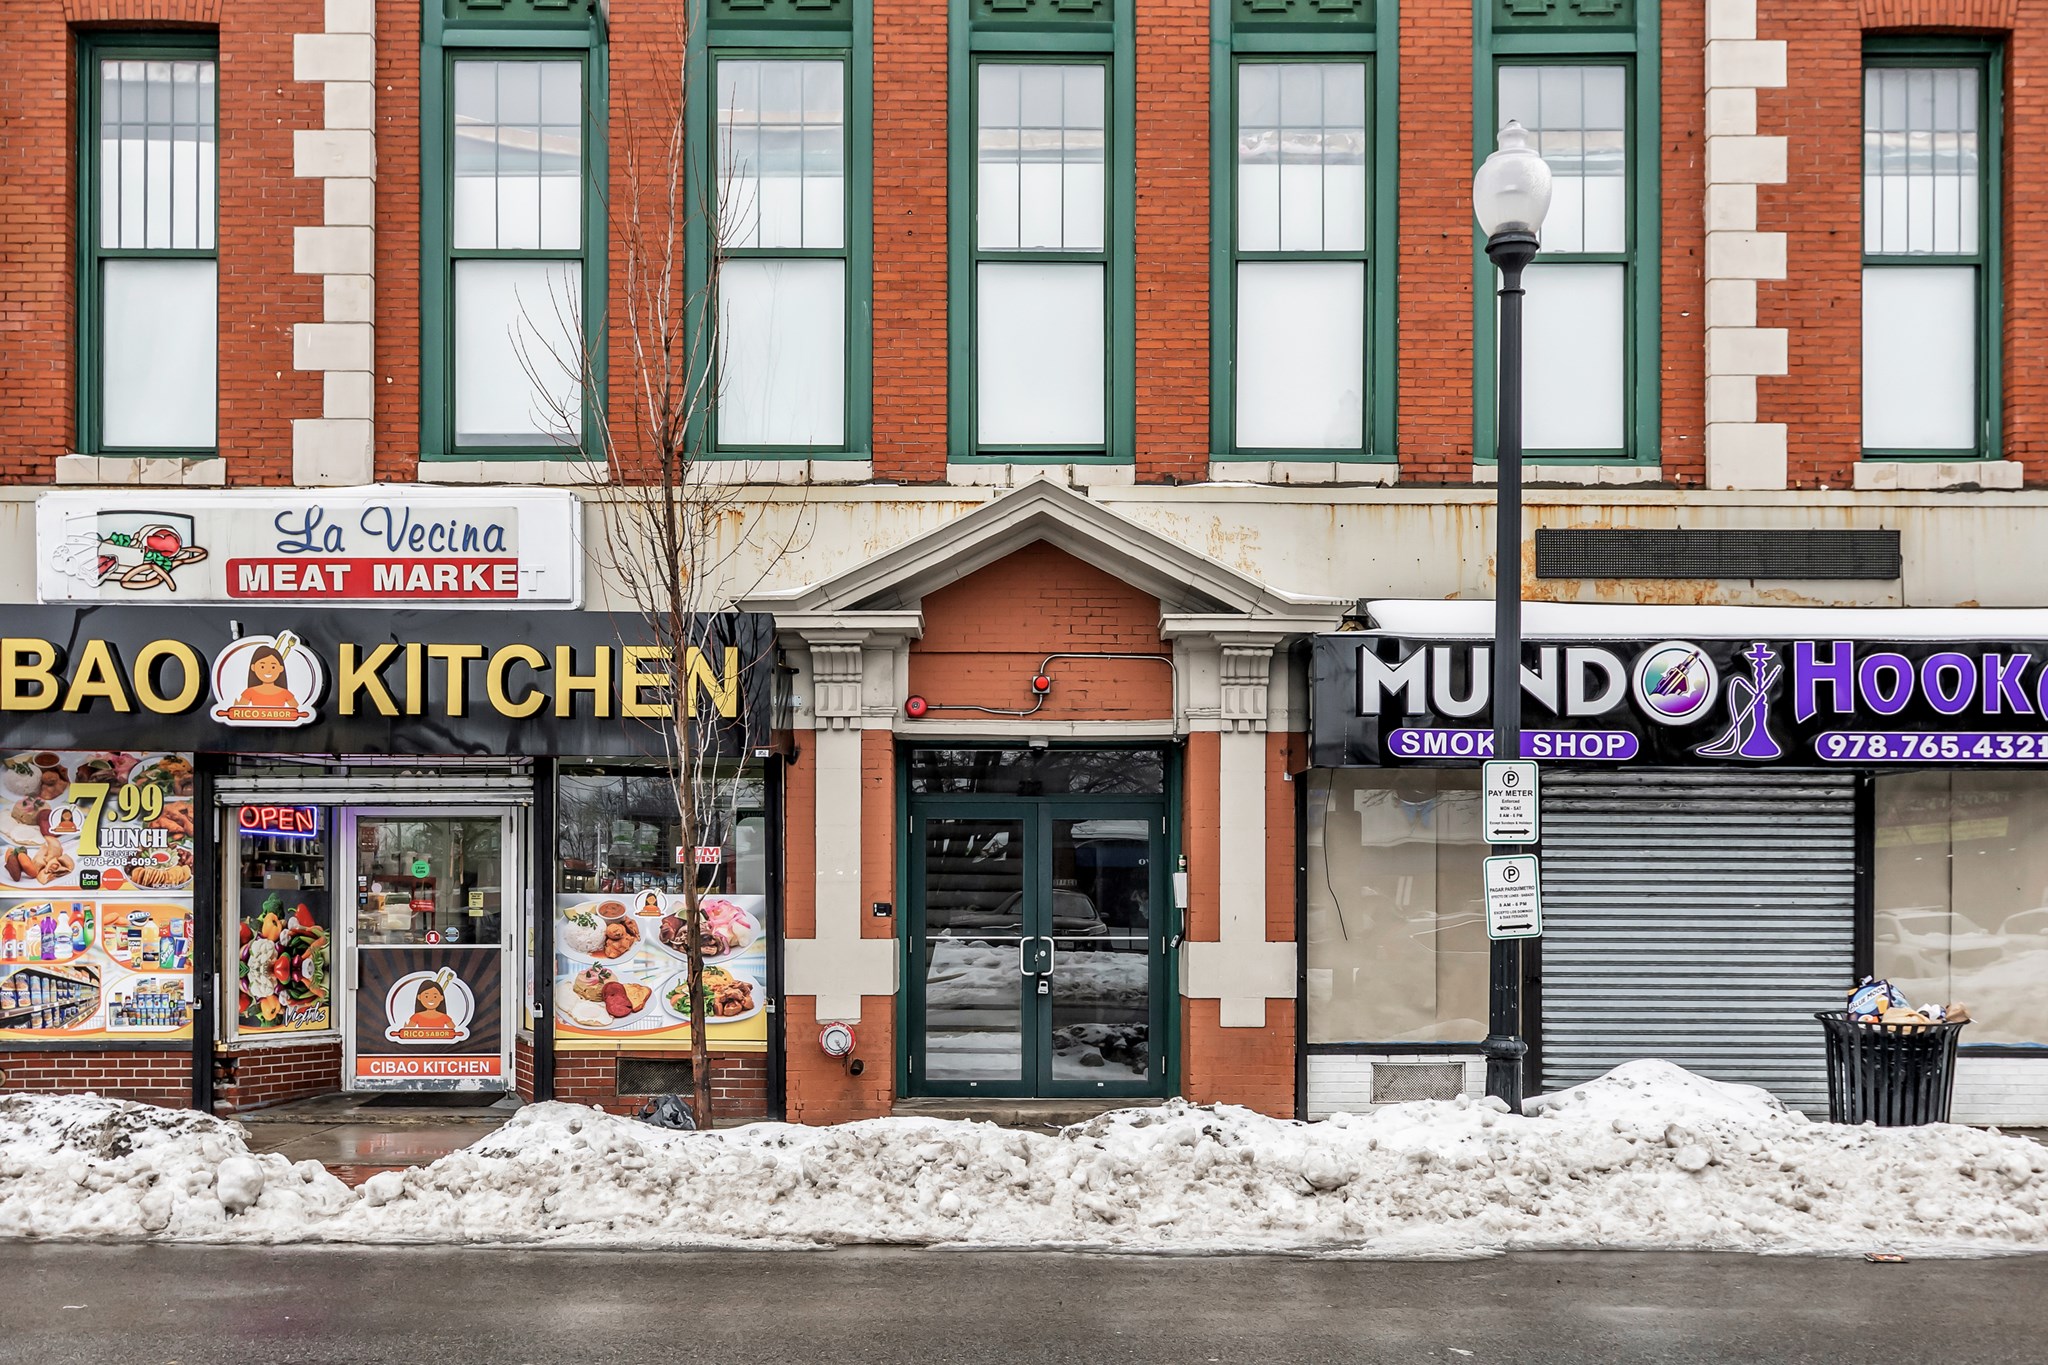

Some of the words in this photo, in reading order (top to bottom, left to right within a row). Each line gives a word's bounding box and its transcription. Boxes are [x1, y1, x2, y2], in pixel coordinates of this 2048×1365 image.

[275, 505, 345, 554] La
[360, 506, 507, 552] Vecina
[238, 564, 351, 592] MEAT
[373, 564, 546, 592] MARKET
[0, 638, 200, 714] BAO
[338, 643, 739, 719] KITCHEN
[1794, 641, 2048, 724] HOOK
[233, 708, 260, 719] RICO
[261, 709, 292, 719] SABOR
[1401, 731, 1494, 756] SMOK
[1532, 733, 1626, 757] SHOP
[1827, 734, 2048, 759] 978.765.4321
[68, 783, 164, 856] 7.99
[240, 806, 314, 832] OPEN
[100, 828, 168, 849] LUNCH
[84, 858, 158, 867] 978-208-6093
[1849, 997, 1866, 1010] BLUE
[1866, 986, 1886, 1000] MOON
[403, 1030, 424, 1038] RICO
[370, 1061, 419, 1074] CIBAO
[423, 1061, 490, 1073] KITCHEN
